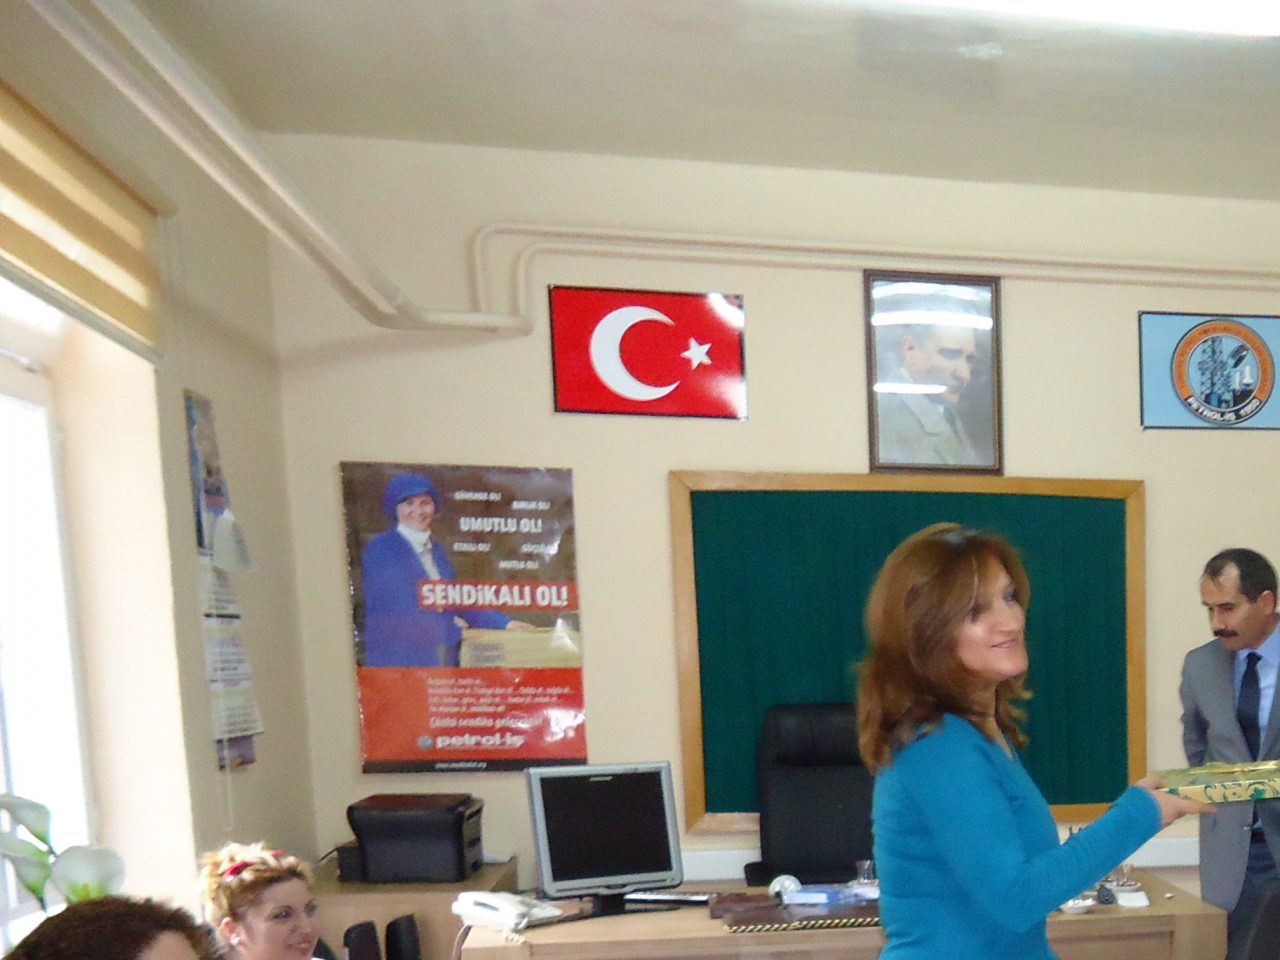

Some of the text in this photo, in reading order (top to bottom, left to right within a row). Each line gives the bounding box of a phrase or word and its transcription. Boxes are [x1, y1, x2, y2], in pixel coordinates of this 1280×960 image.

[460, 517, 542, 534] UMUTLU OL!
[536, 585, 569, 606] OL!
